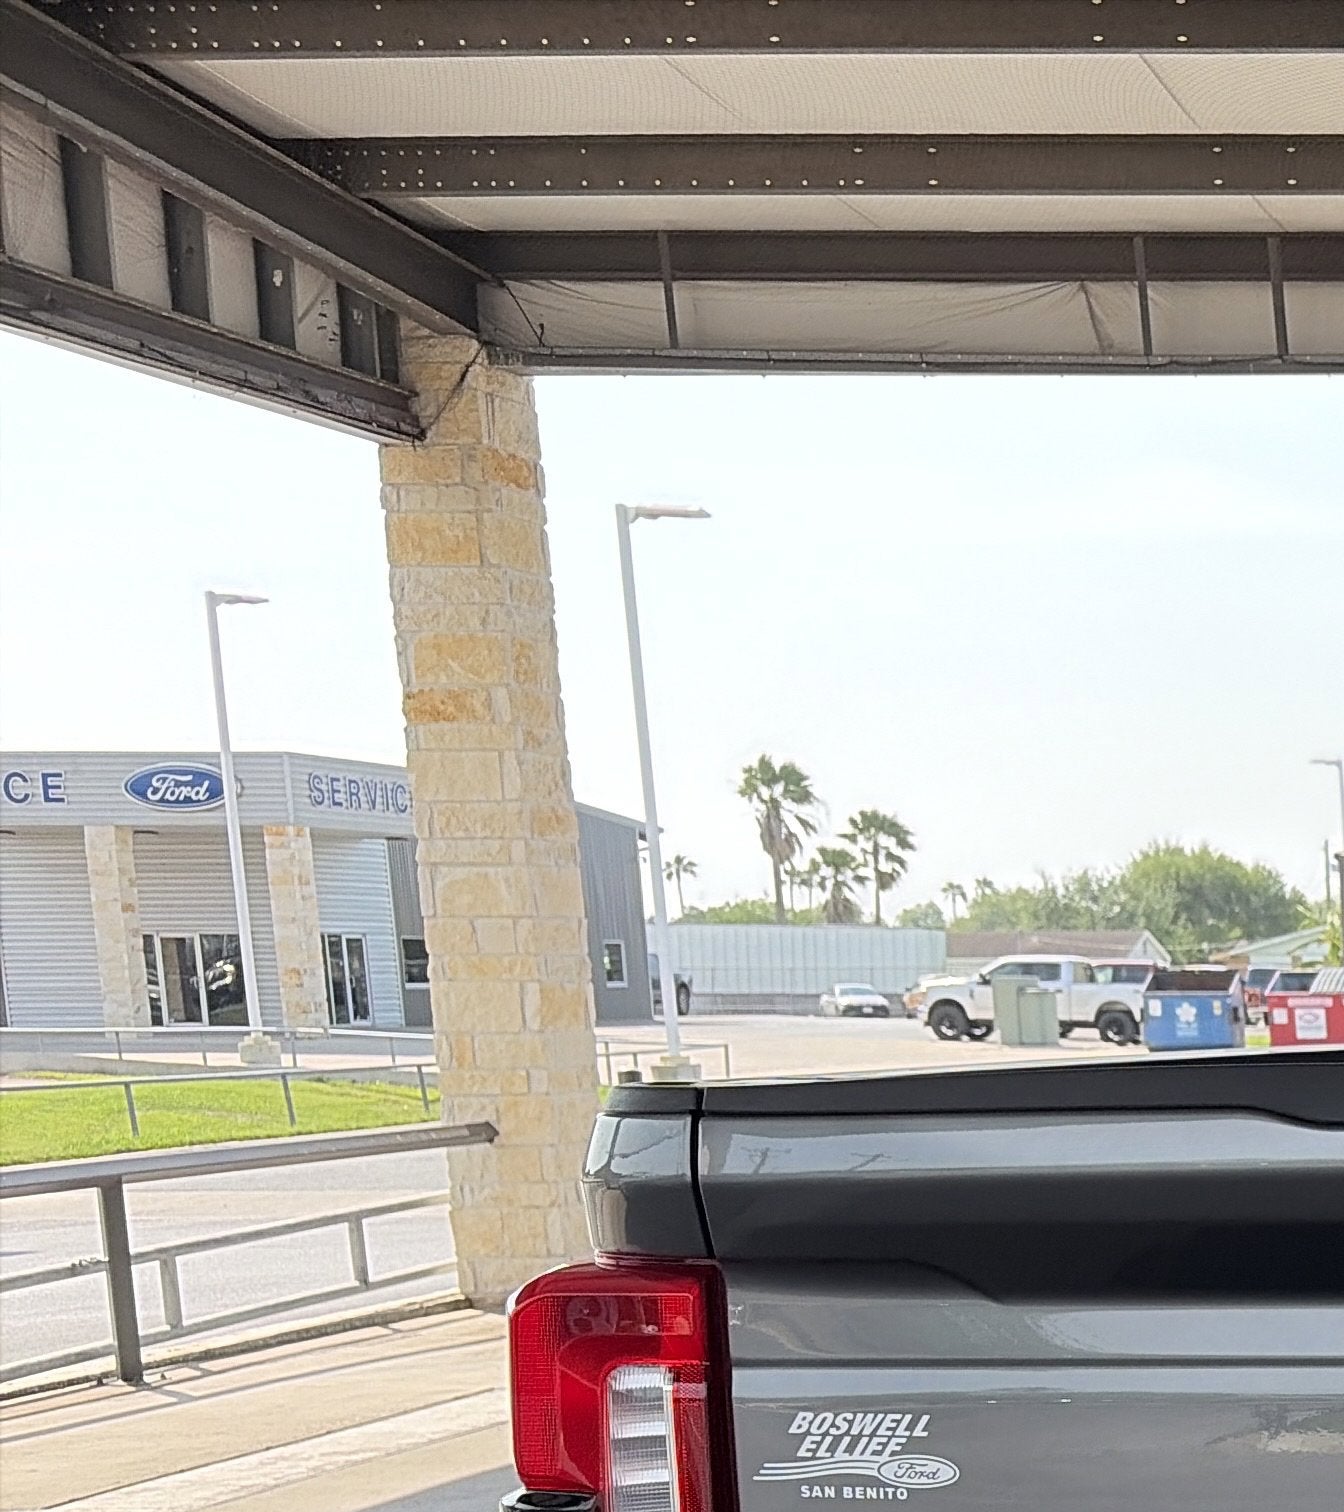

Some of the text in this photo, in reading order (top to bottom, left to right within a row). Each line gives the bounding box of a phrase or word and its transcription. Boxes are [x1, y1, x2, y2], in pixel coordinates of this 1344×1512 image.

[146, 773, 210, 801] Ford
[308, 771, 414, 815] SERVIC
[788, 1411, 931, 1437] BOSWELL
[796, 1435, 908, 1458] ELLIFF
[894, 1462, 940, 1481] Ford
[800, 1485, 908, 1500] SAN BENITO
